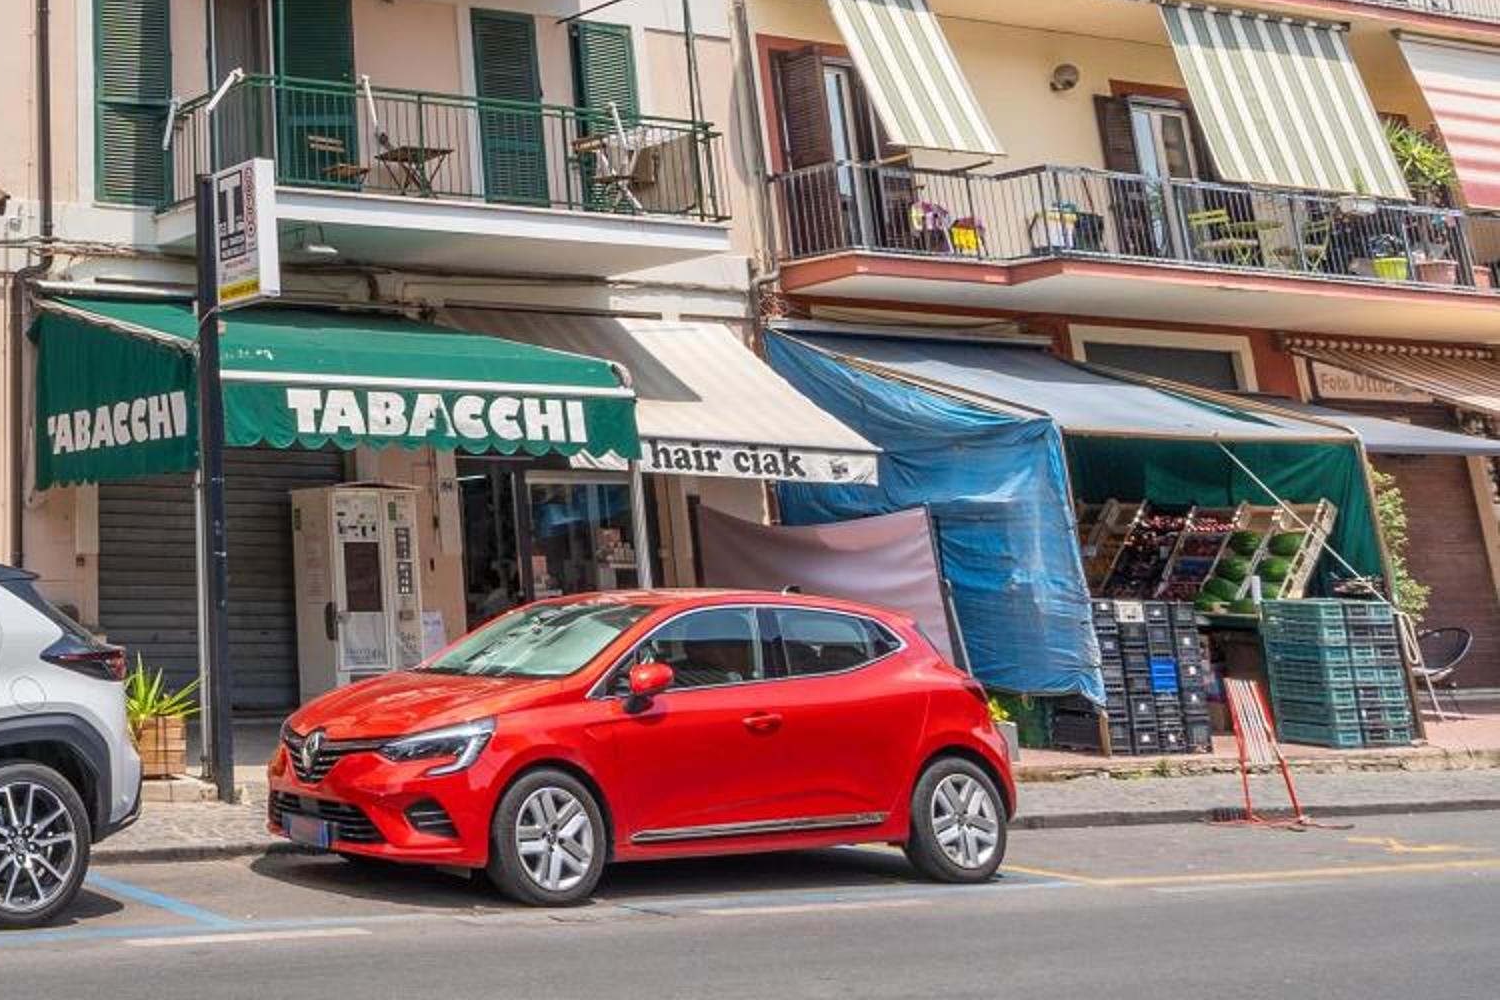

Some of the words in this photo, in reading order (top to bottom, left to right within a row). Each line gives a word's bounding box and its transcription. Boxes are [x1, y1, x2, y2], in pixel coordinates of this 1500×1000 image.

[1321, 374, 1351, 392] Foto
[286, 388, 588, 442] TABACCHI
[649, 439, 721, 472] hair
[733, 445, 806, 477] ciak
